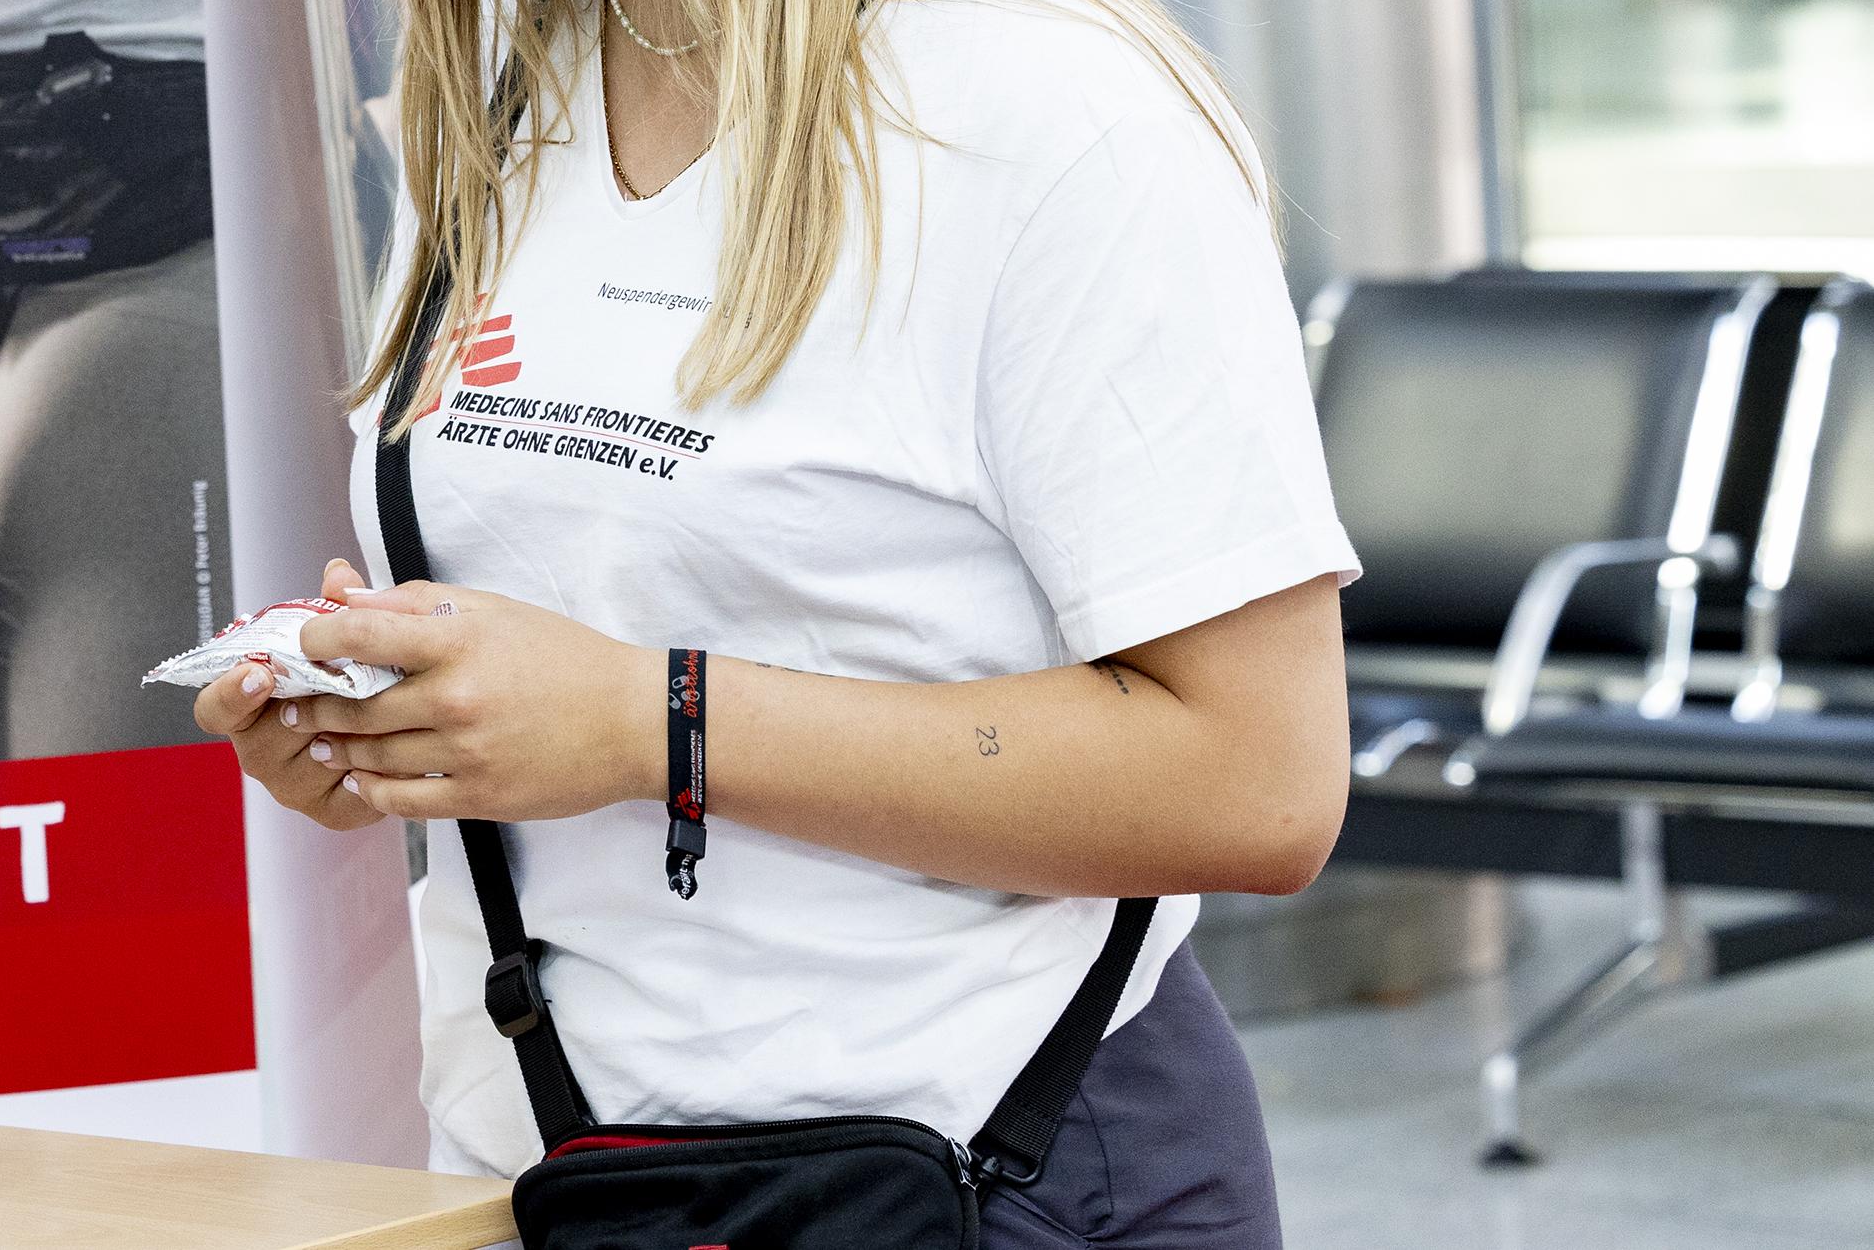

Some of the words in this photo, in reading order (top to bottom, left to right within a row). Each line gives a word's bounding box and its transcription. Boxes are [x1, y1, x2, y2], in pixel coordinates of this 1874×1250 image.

[437, 416, 502, 447] ÄRZTE
[503, 429, 553, 453] OHNE
[554, 435, 638, 469] GRENZEN
[639, 456, 678, 481] e.V.
[449, 390, 541, 420] MEDECINS
[539, 401, 583, 424] SANS
[582, 406, 715, 454] FRONTIERES
[975, 725, 1000, 757] 23
